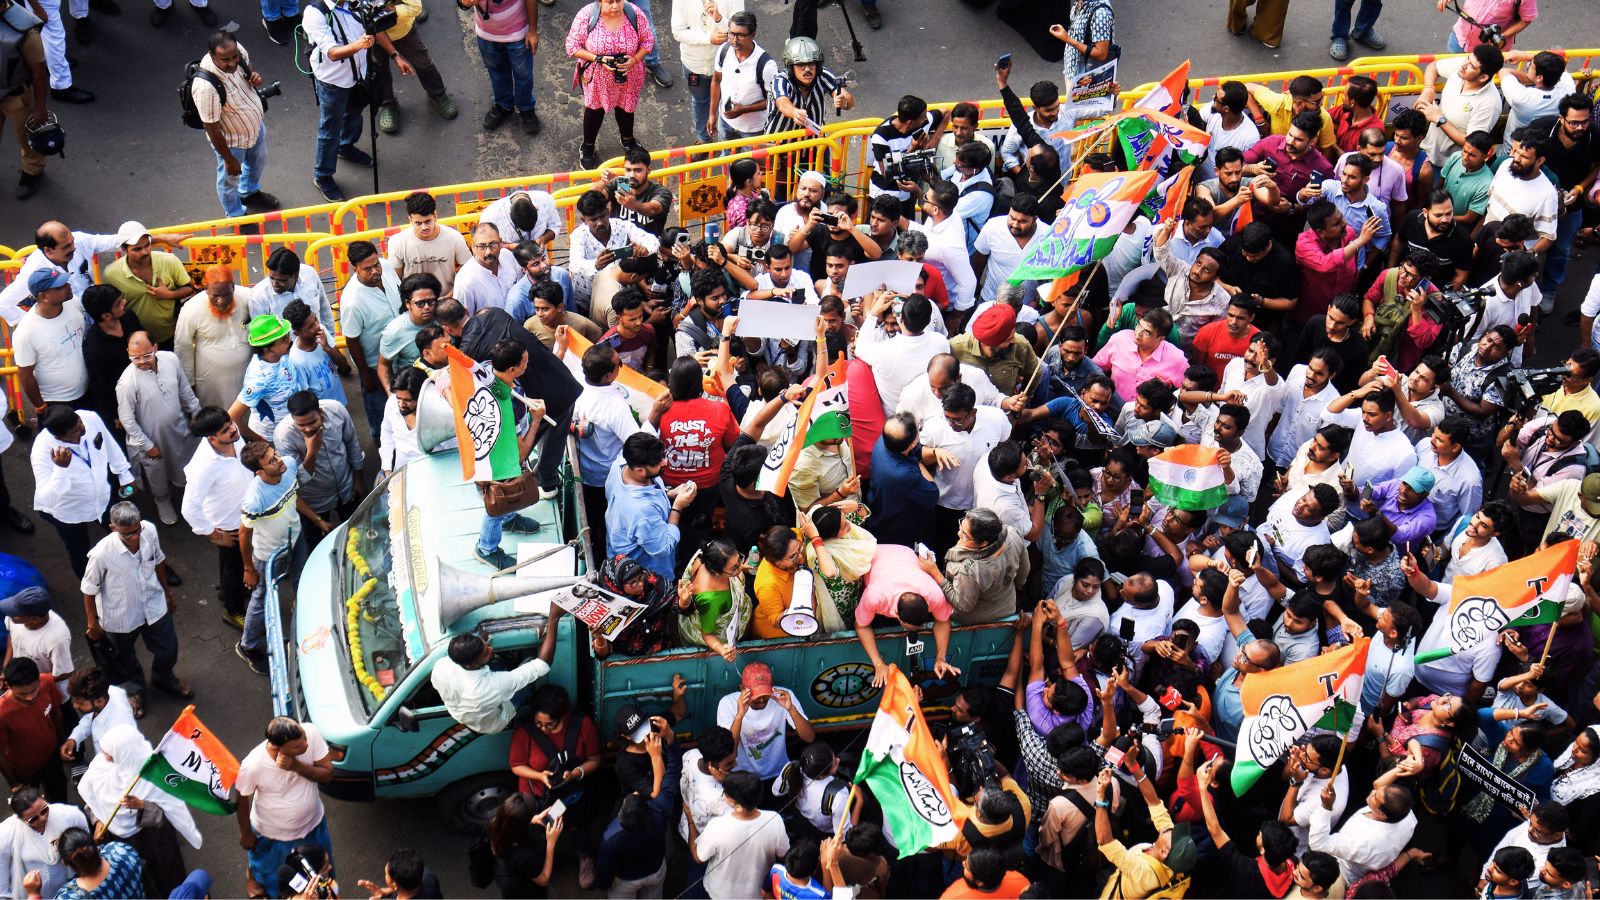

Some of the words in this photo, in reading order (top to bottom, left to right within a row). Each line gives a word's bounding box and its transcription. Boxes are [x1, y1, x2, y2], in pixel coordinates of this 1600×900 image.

[669, 419, 706, 433] TRUST
[674, 433, 699, 448] THE
[408, 511, 419, 540] GOODS
[411, 544, 427, 588] CARRIAGE
[1528, 577, 1548, 596] T
[584, 602, 612, 628] NOW!
[908, 645, 923, 653] ANI
[815, 683, 881, 706] HIRE
[1319, 673, 1338, 698] T
[626, 714, 640, 730] KTM
[181, 750, 202, 774] M
